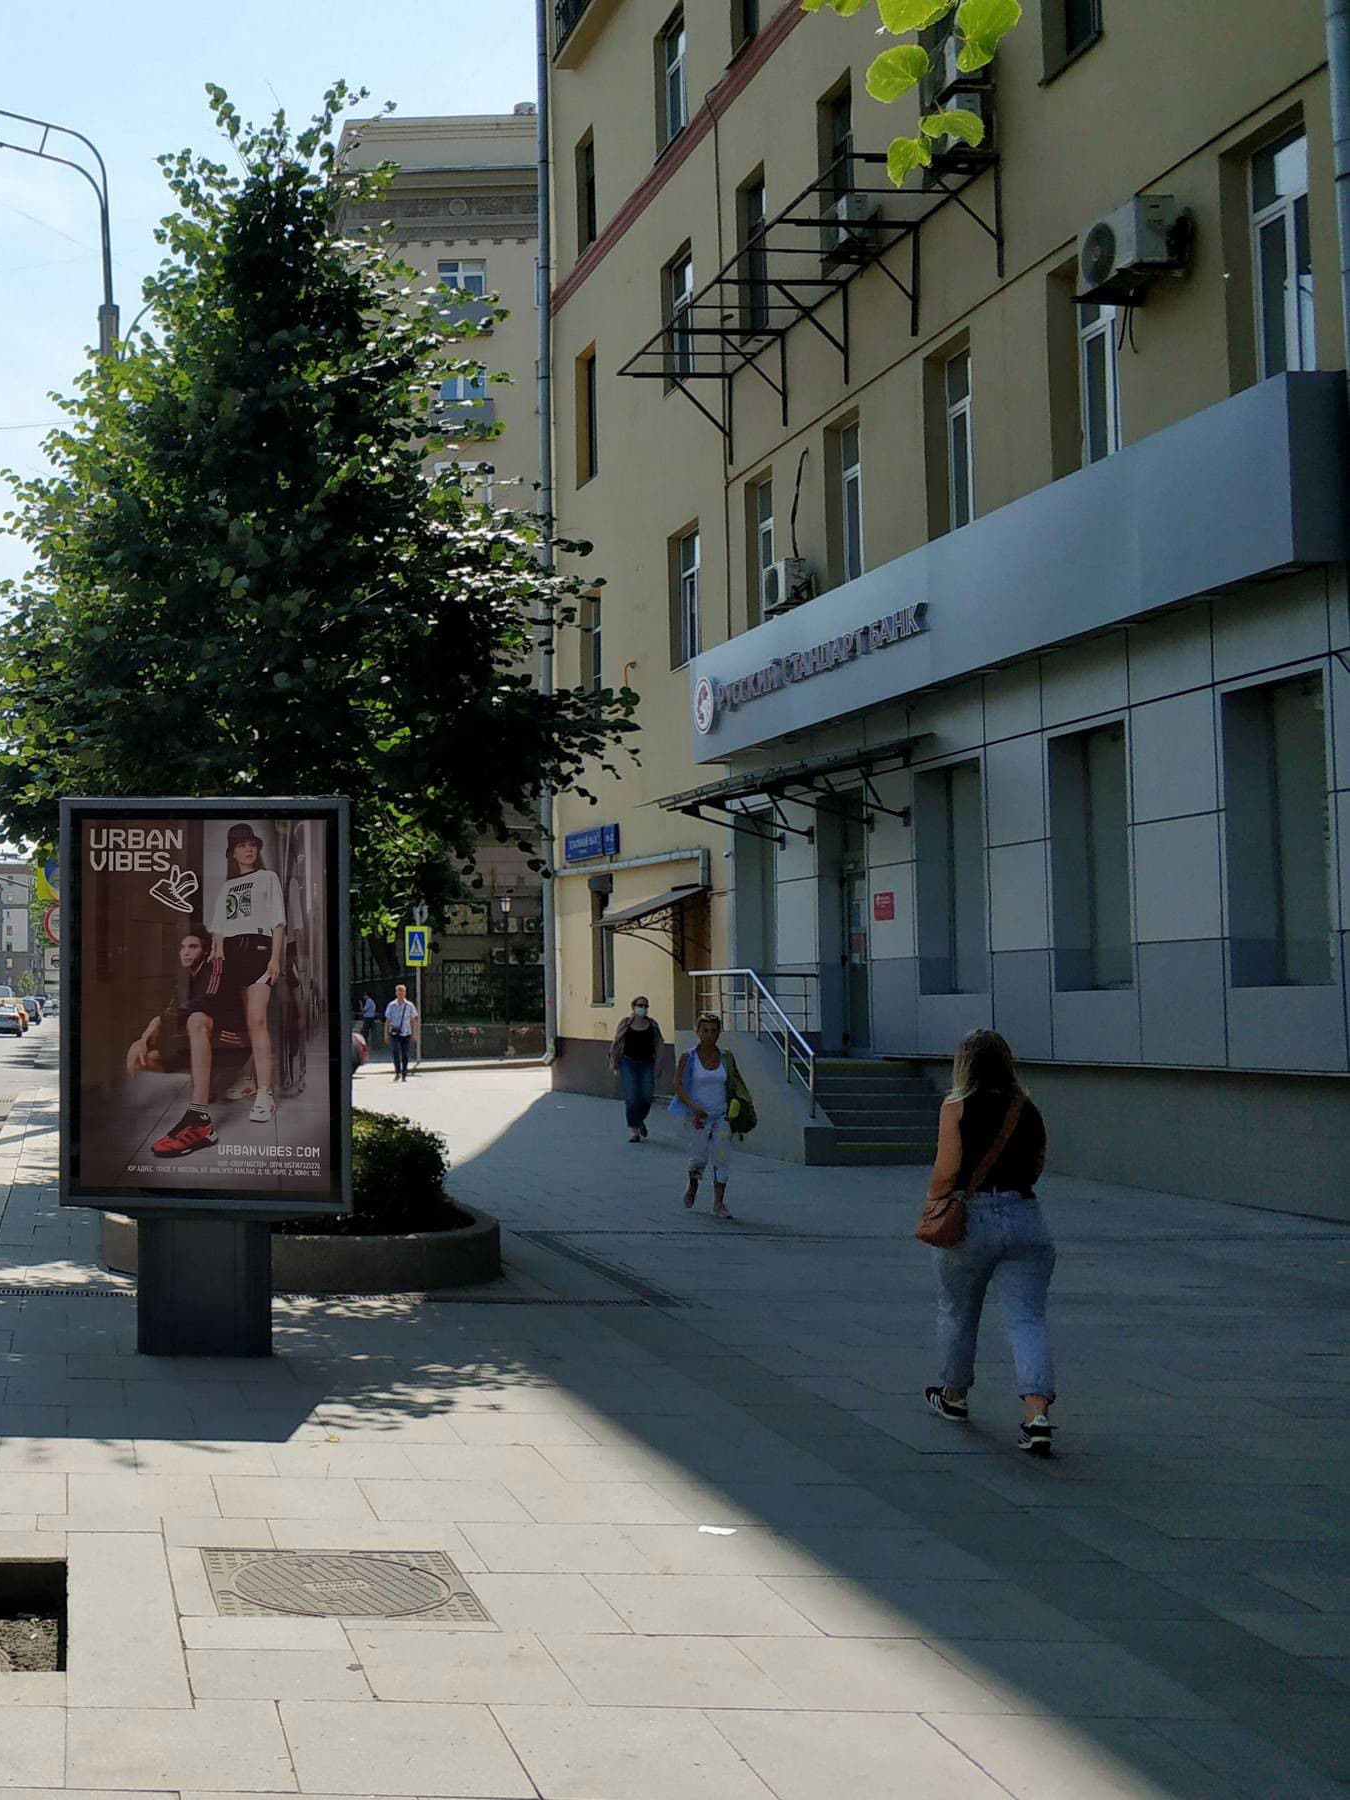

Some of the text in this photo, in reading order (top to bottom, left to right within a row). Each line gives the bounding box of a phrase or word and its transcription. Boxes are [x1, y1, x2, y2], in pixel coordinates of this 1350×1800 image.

[717, 602, 927, 710] РУССКИЙ СТАНДАРТ БАНК
[90, 829, 183, 849] URBAN
[90, 851, 171, 872] VIBES
